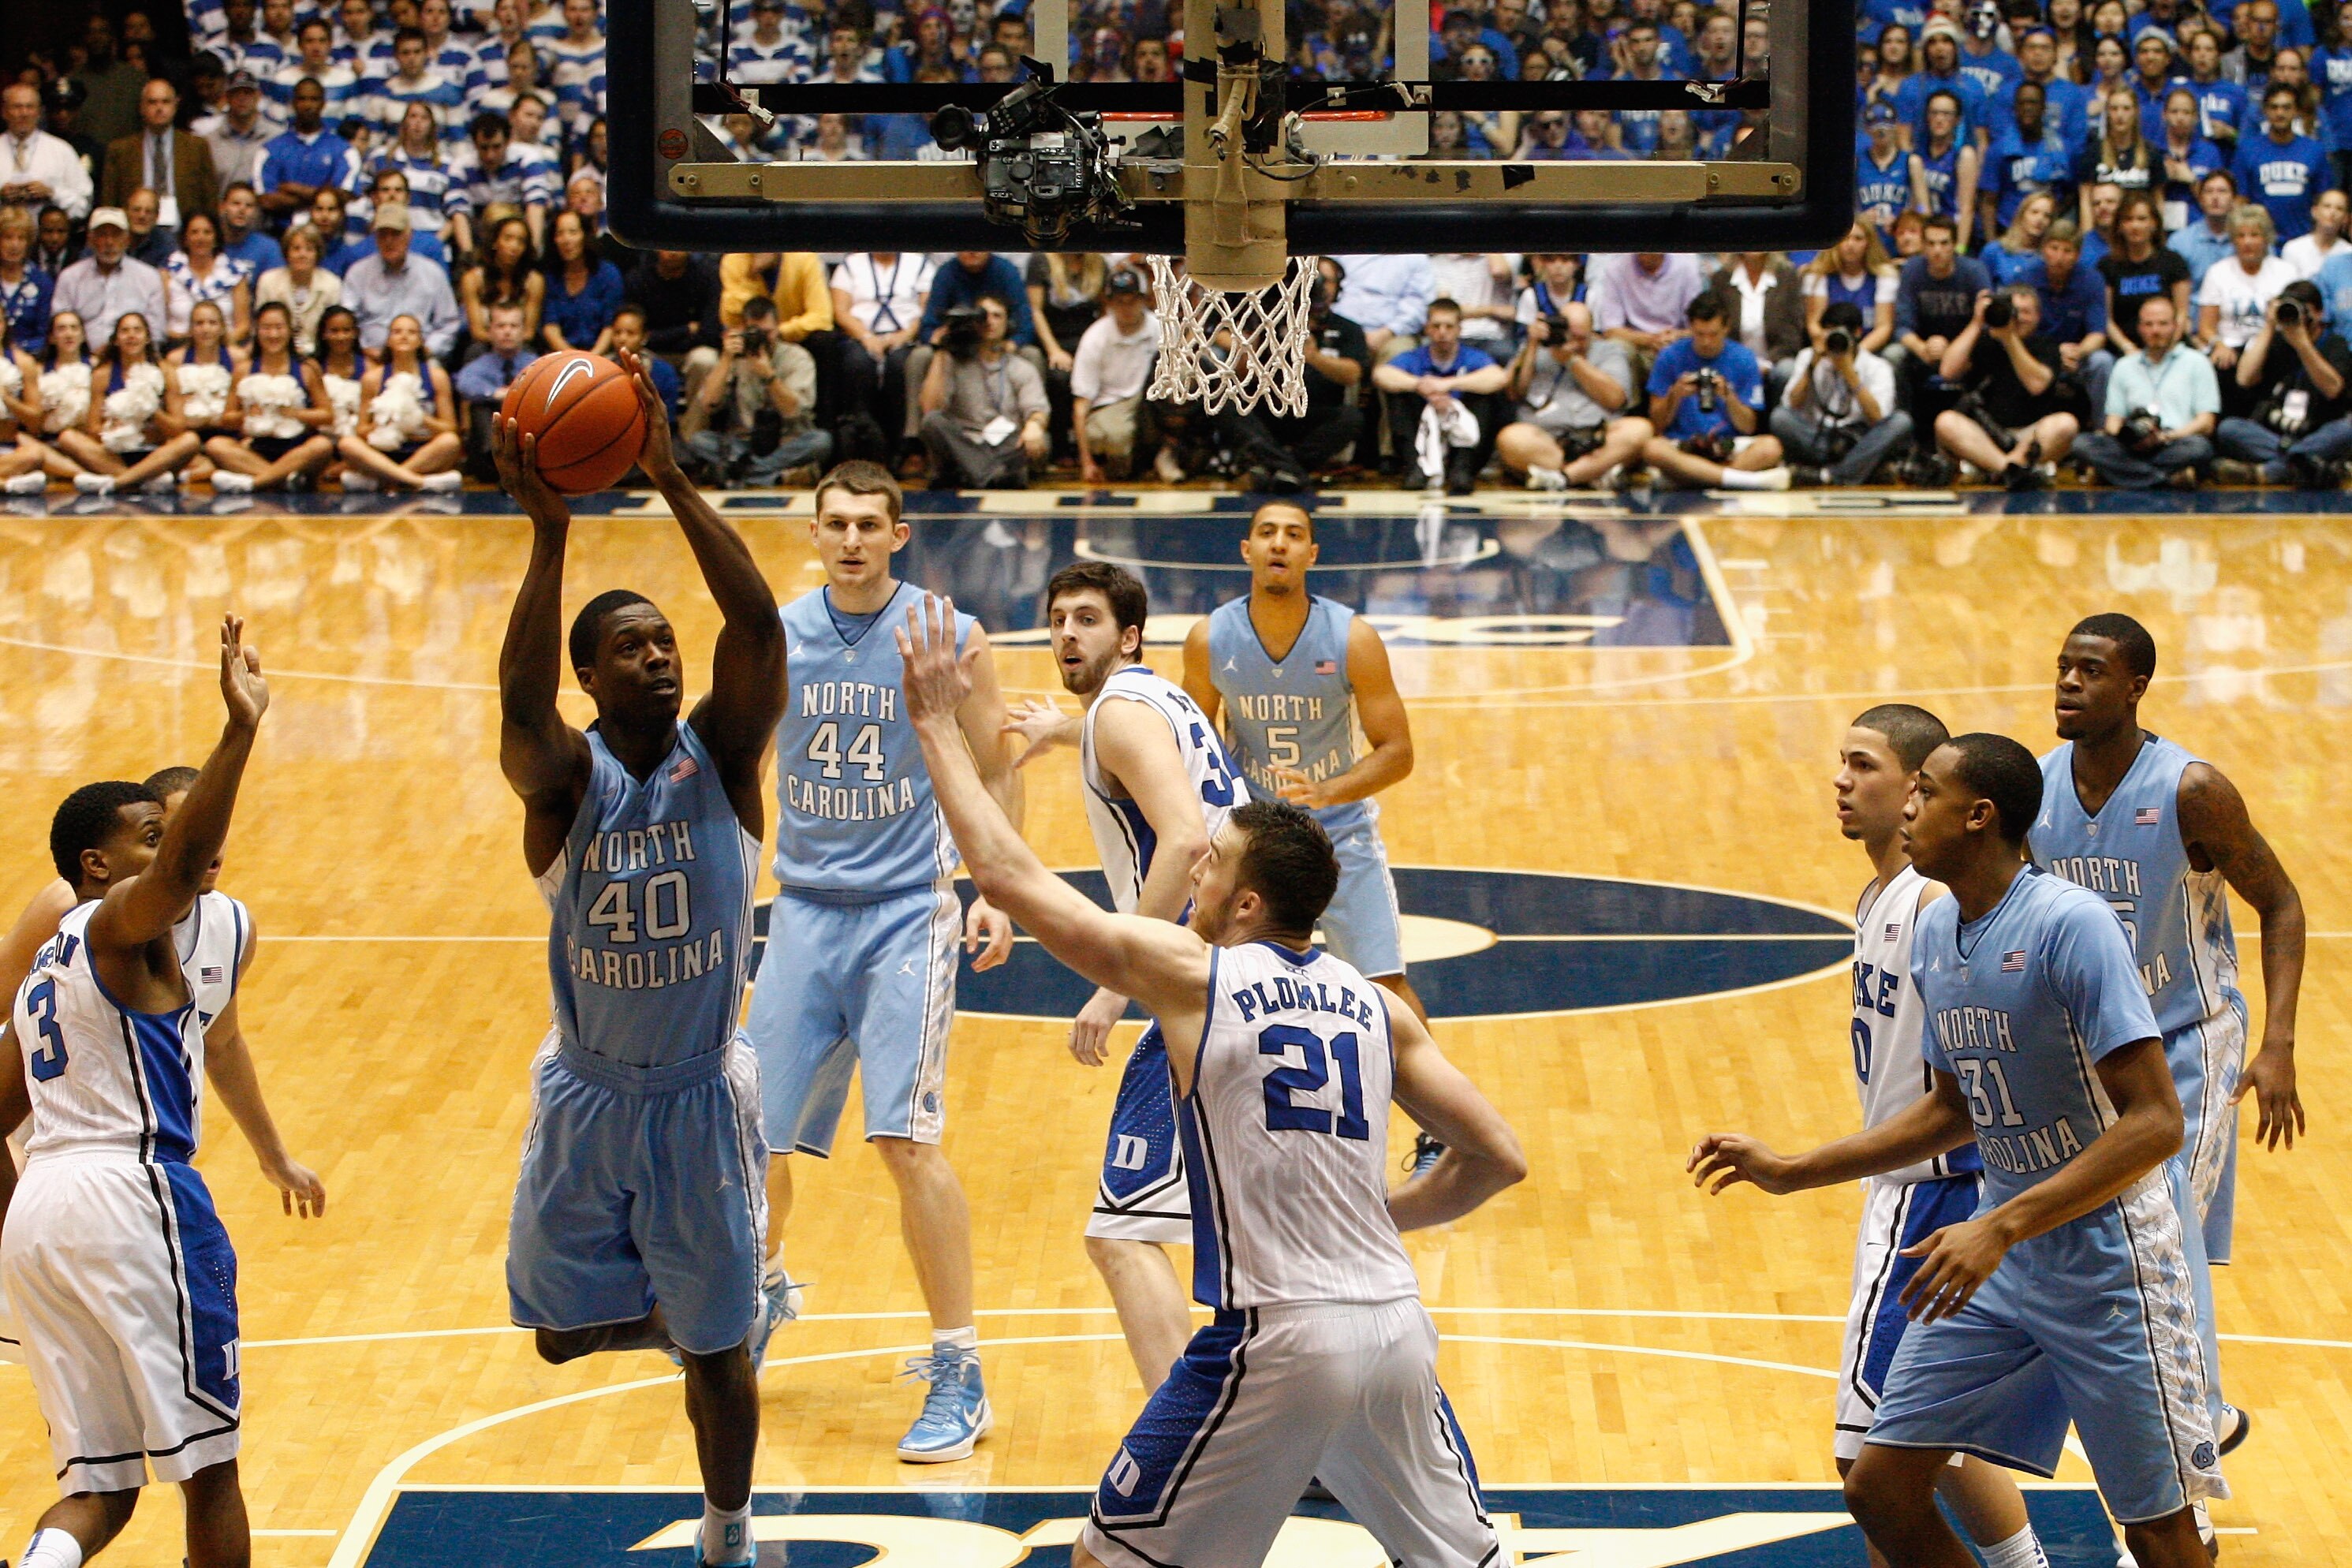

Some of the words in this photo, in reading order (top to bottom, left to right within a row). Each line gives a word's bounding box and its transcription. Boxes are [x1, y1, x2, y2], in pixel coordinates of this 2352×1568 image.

[2259, 161, 2308, 185] DUKE
[802, 681, 896, 722] NORTH
[1238, 694, 1323, 722] NORTH
[807, 721, 886, 781] 44
[1265, 726, 1301, 767] 5
[788, 774, 917, 821] CAROLINA
[583, 820, 696, 873] NORTH
[2051, 856, 2142, 898] NORTH
[586, 869, 691, 943] 40
[566, 929, 724, 990] CAROLINA
[28, 976, 69, 1083] 3
[1232, 976, 1373, 1032] PLUMLEE
[1937, 1006, 2018, 1053] NORTH
[1258, 1024, 1369, 1141] 21
[1954, 1058, 2026, 1128] 31
[1111, 1133, 1148, 1170] D
[1108, 1445, 1141, 1497] D
